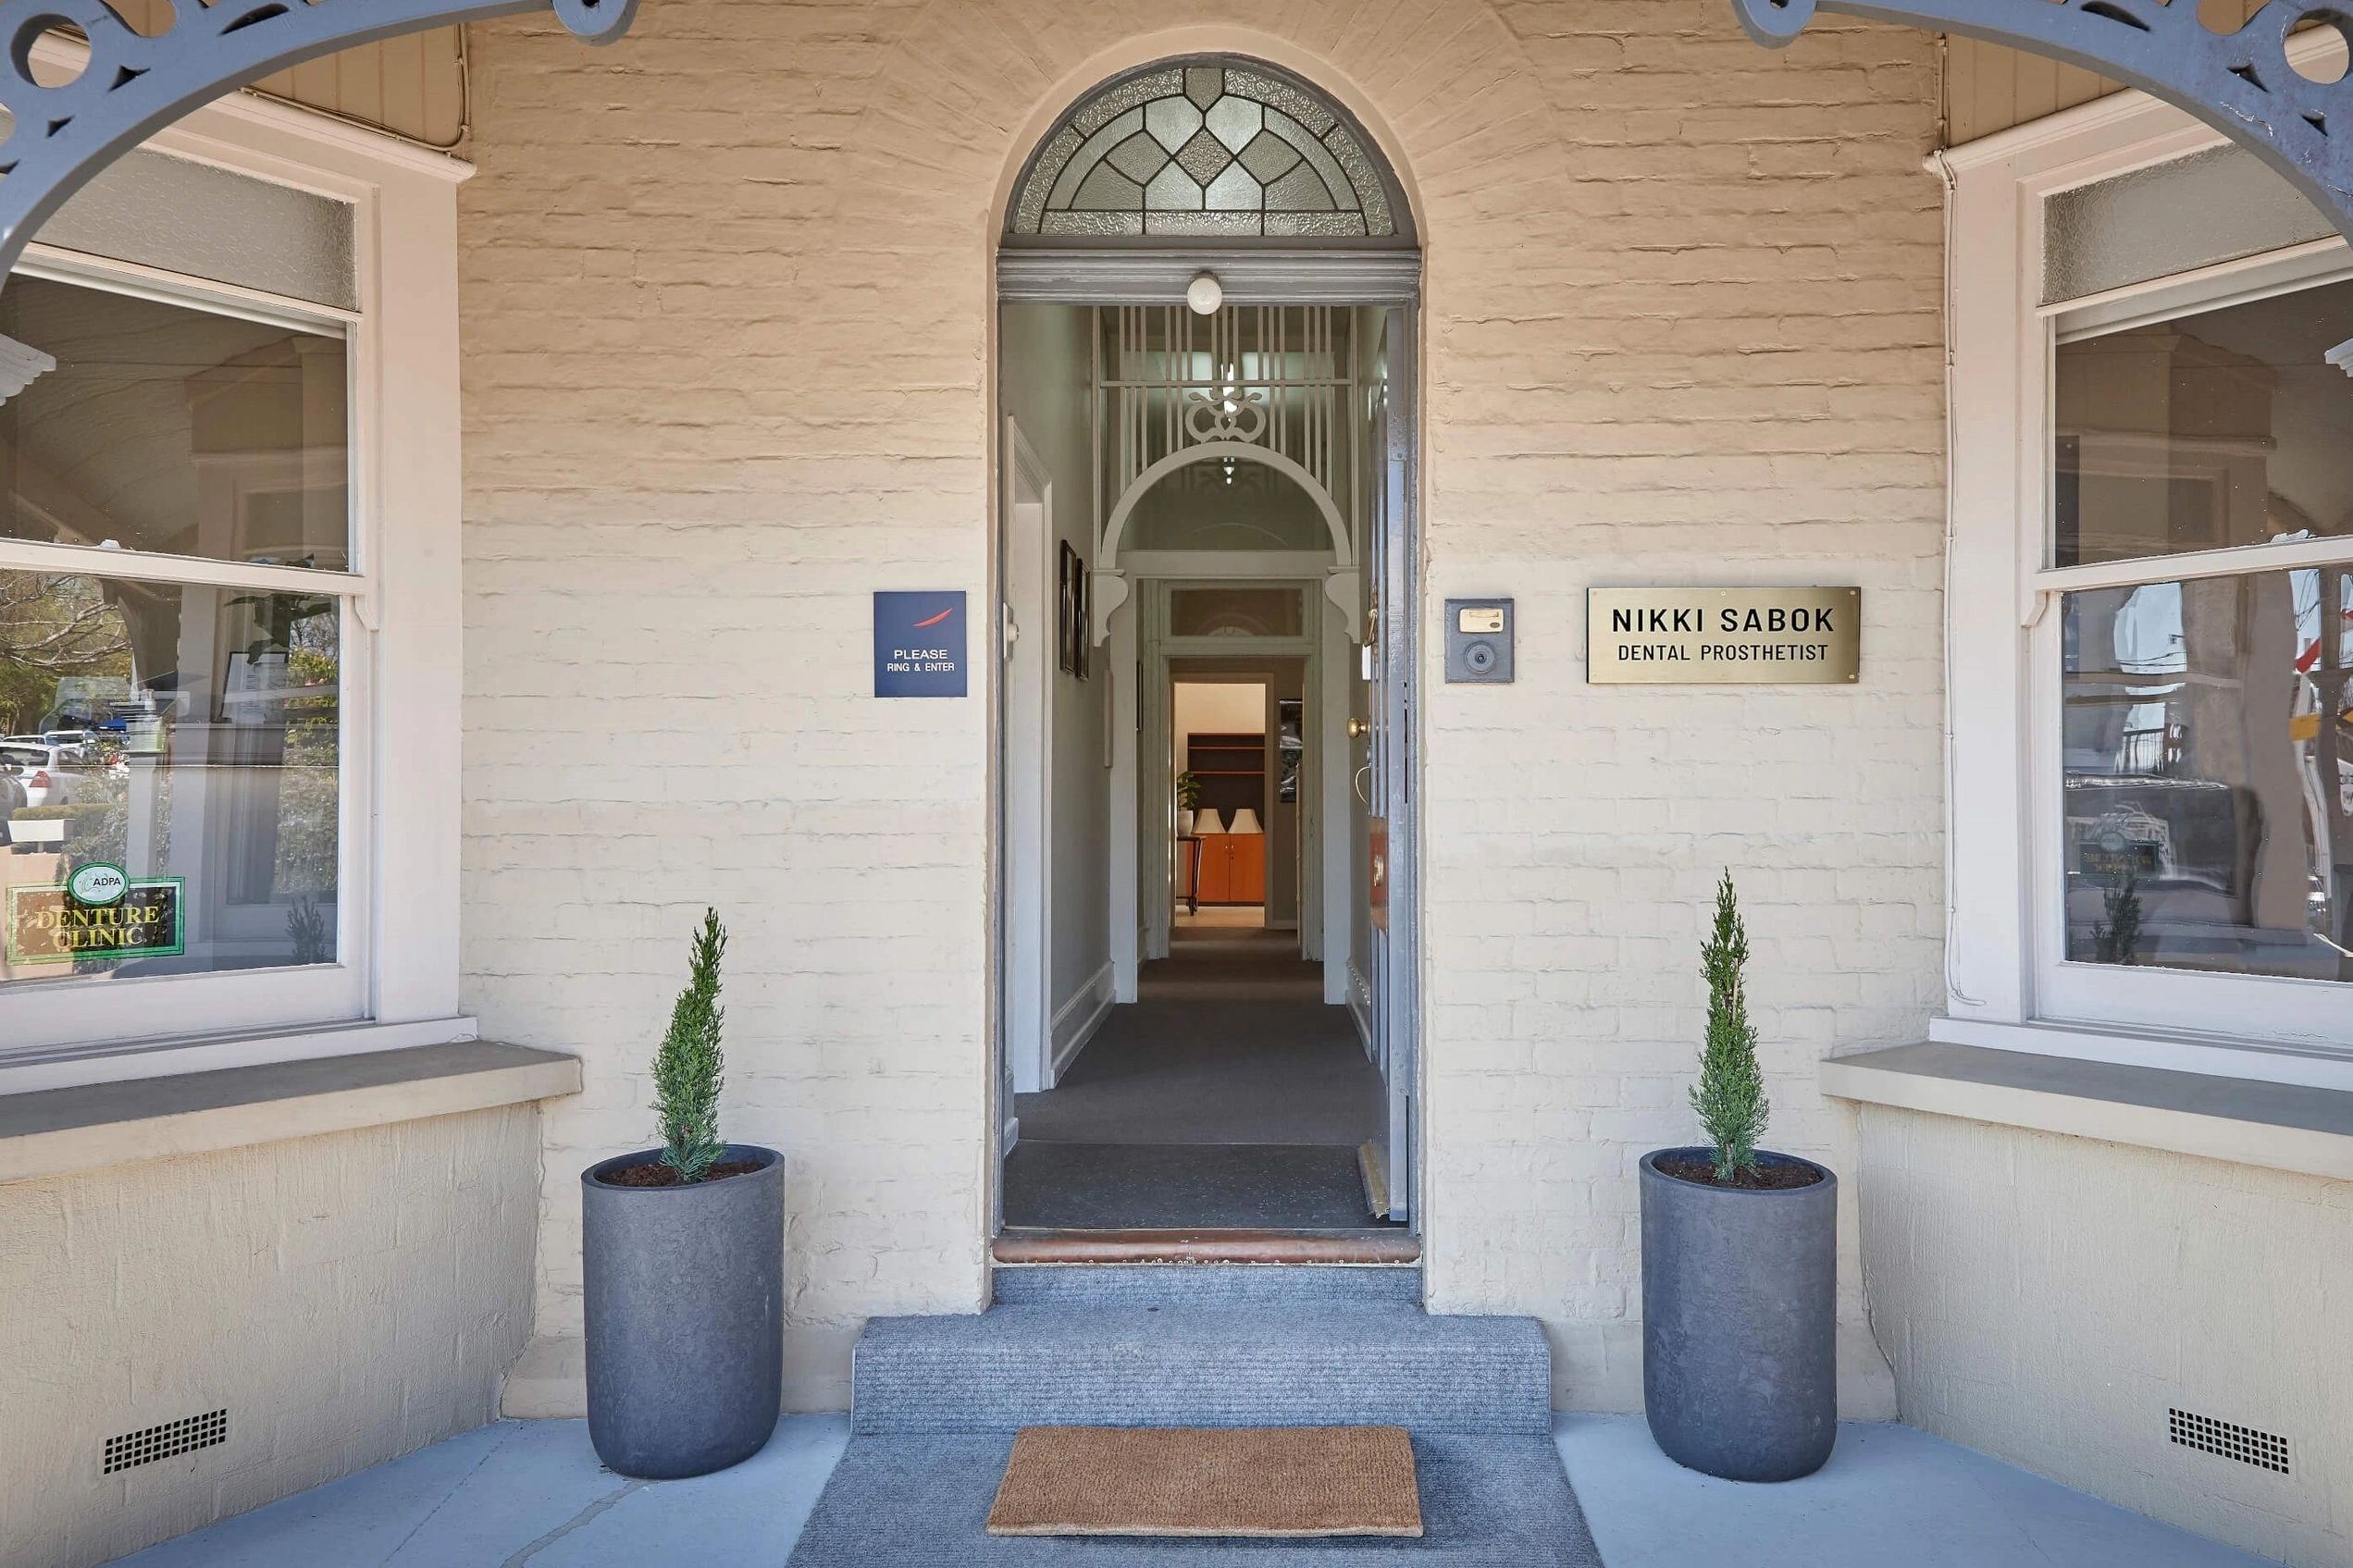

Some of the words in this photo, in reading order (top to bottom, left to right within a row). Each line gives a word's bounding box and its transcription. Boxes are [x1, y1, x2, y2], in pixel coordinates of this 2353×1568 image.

[1613, 609, 1703, 633] NIKKI
[1720, 608, 1835, 633] SABOK
[894, 649, 948, 660] PLEASE
[1618, 645, 1690, 661] DENTAL
[1701, 644, 1829, 661] PROSTHETIST
[886, 662, 910, 672] RING
[913, 662, 922, 672] &
[924, 661, 955, 672] ENTER
[93, 877, 121, 886] ADPA
[35, 906, 160, 929] DENTURE
[52, 928, 143, 949] CLINIC
